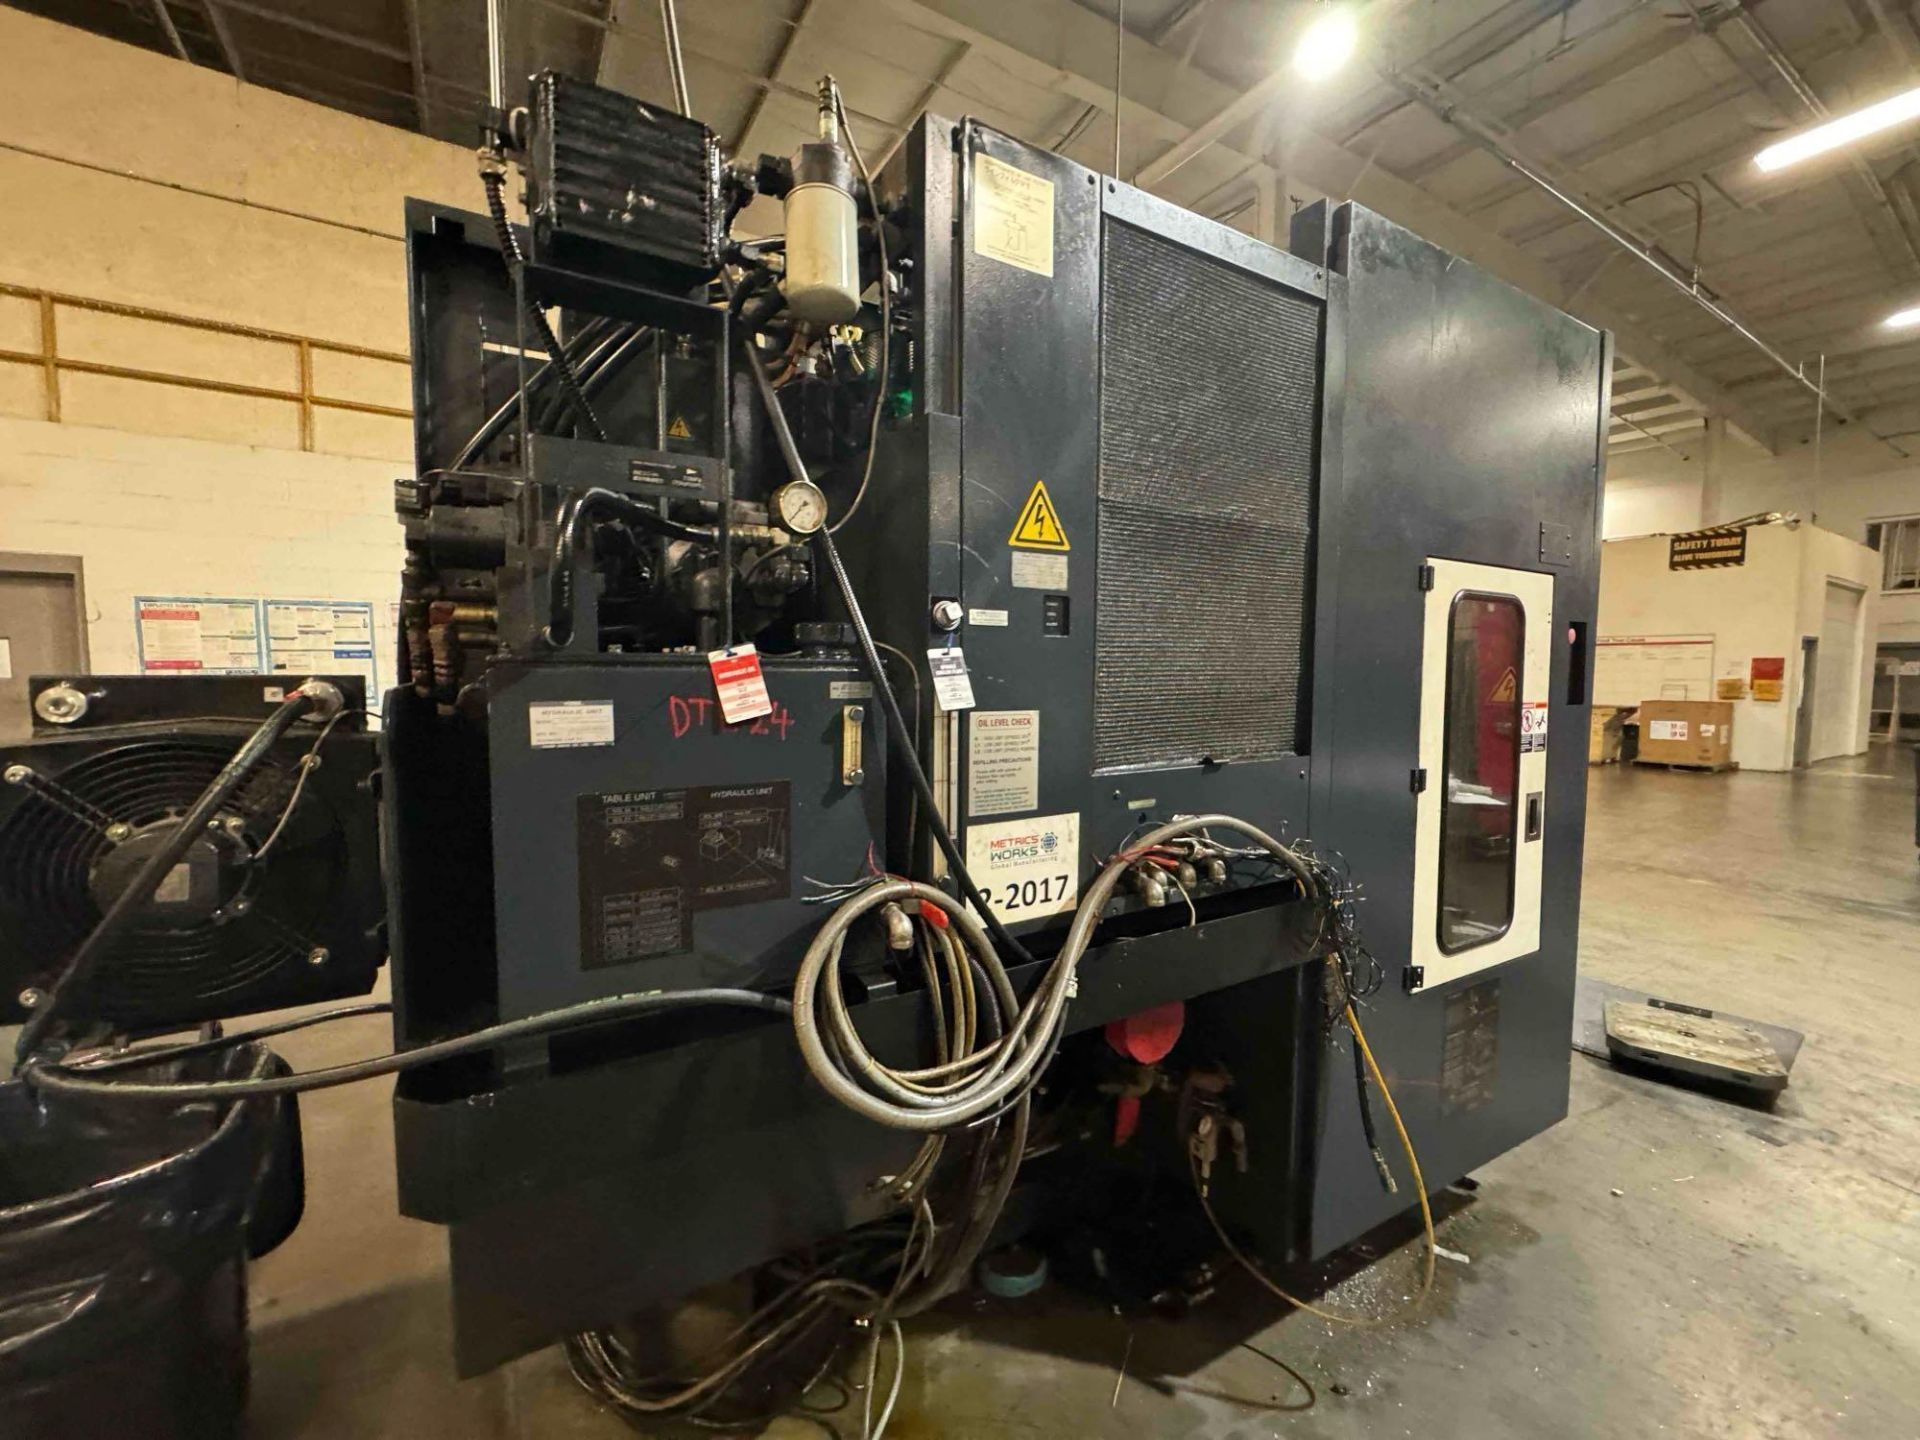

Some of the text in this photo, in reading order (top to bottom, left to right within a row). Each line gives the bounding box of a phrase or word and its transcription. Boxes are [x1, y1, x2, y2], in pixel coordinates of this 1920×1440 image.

[1673, 536, 1743, 551] SAFETY TODAY
[978, 717, 1032, 728] OIL LEVEL CHECK
[602, 791, 656, 803] TABLE UNIT
[710, 786, 774, 799] HYDRAULIC UNIT
[990, 834, 1040, 849] METRICS
[990, 846, 1039, 861] WORKS
